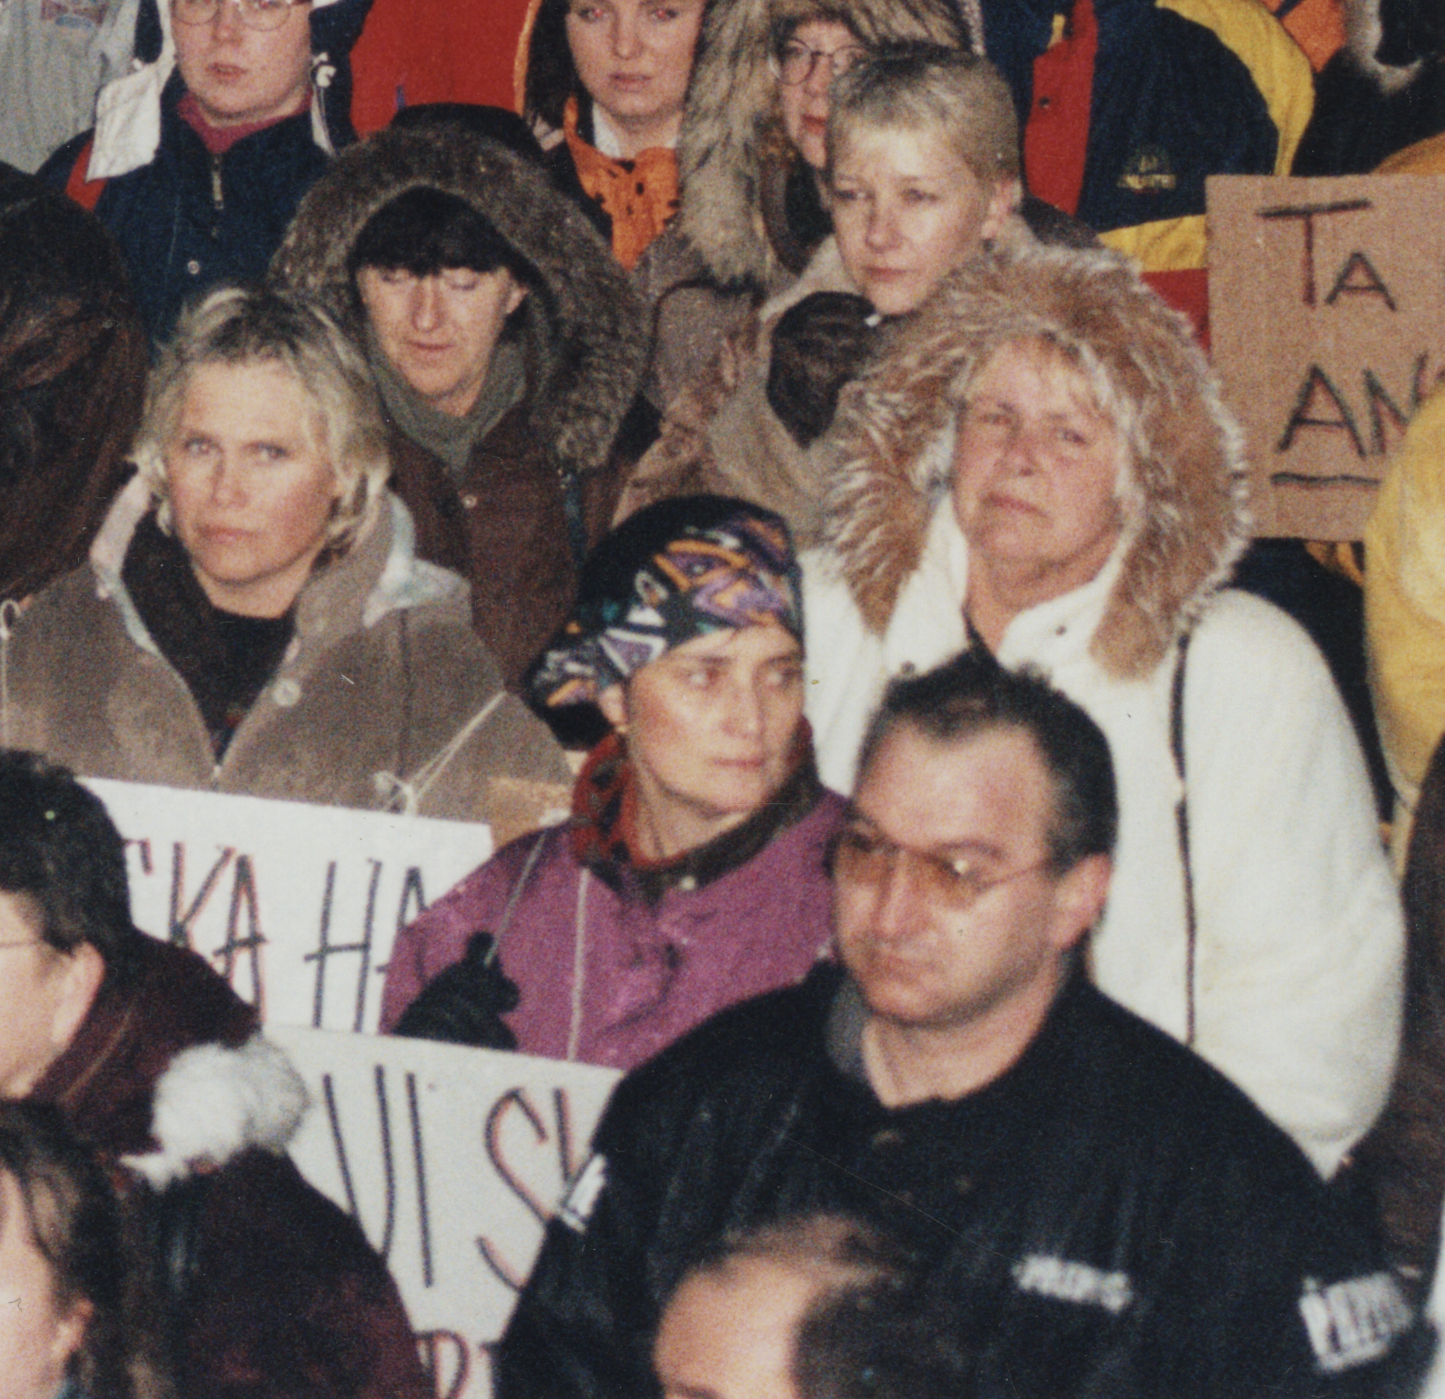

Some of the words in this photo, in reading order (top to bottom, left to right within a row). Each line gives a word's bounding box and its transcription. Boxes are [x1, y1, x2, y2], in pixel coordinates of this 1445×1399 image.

[1255, 197, 1398, 313] TA
[1276, 351, 1445, 459] AN
[121, 839, 273, 1028] KA
